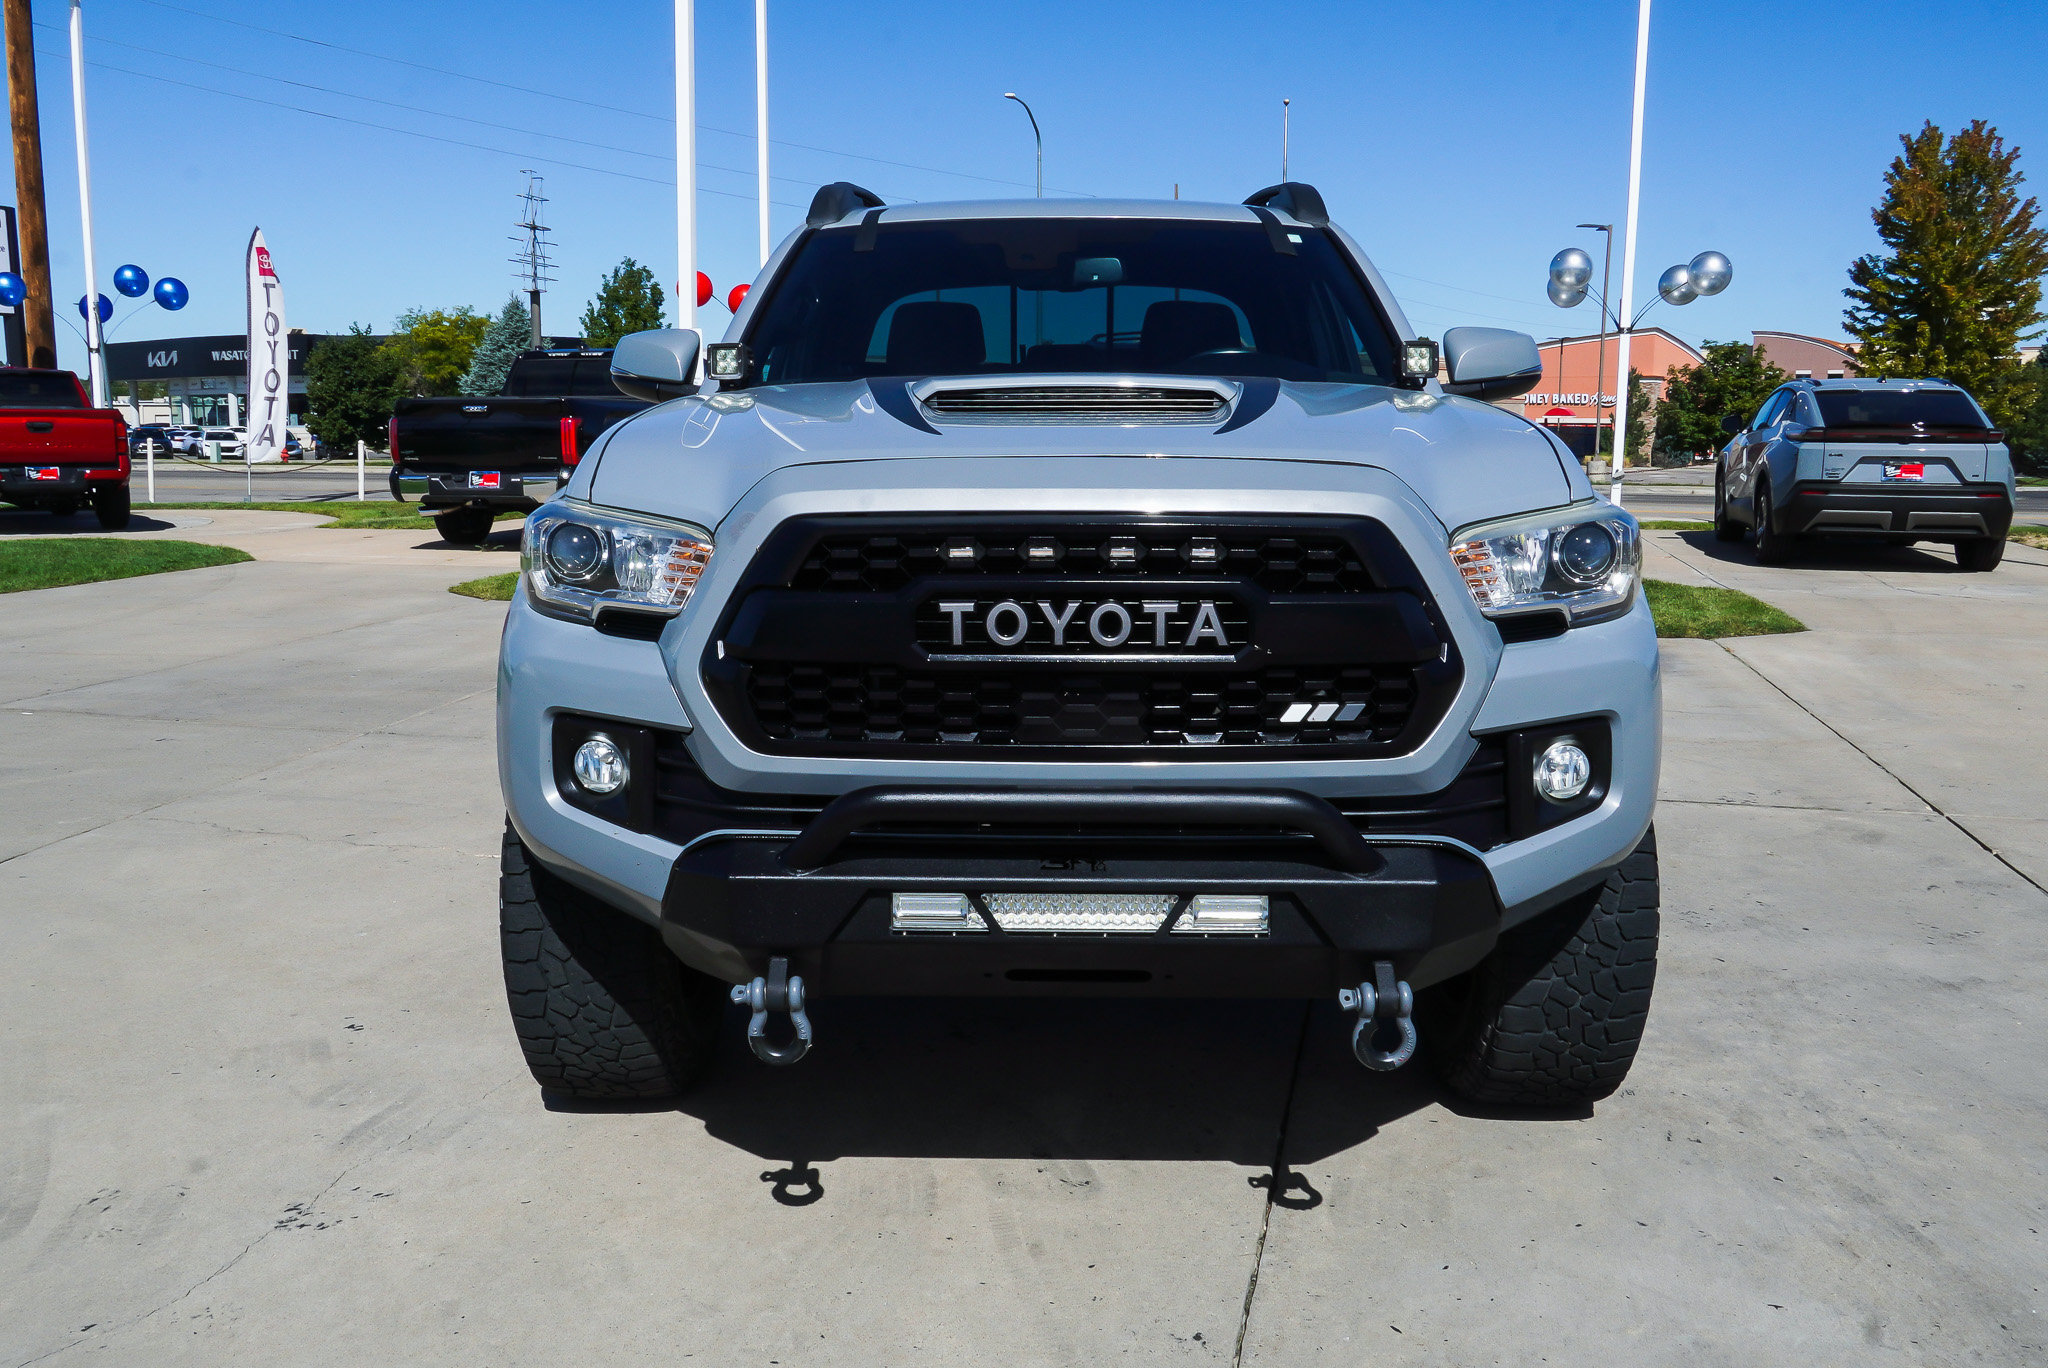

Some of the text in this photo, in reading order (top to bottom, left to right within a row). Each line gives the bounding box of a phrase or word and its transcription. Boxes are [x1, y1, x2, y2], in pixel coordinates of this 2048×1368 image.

[148, 350, 178, 368] KIA
[256, 283, 281, 448] TOYOTA
[1524, 393, 1550, 405] ONEY
[1553, 394, 1588, 405] BAKED
[939, 601, 1229, 647] TOYOTA
